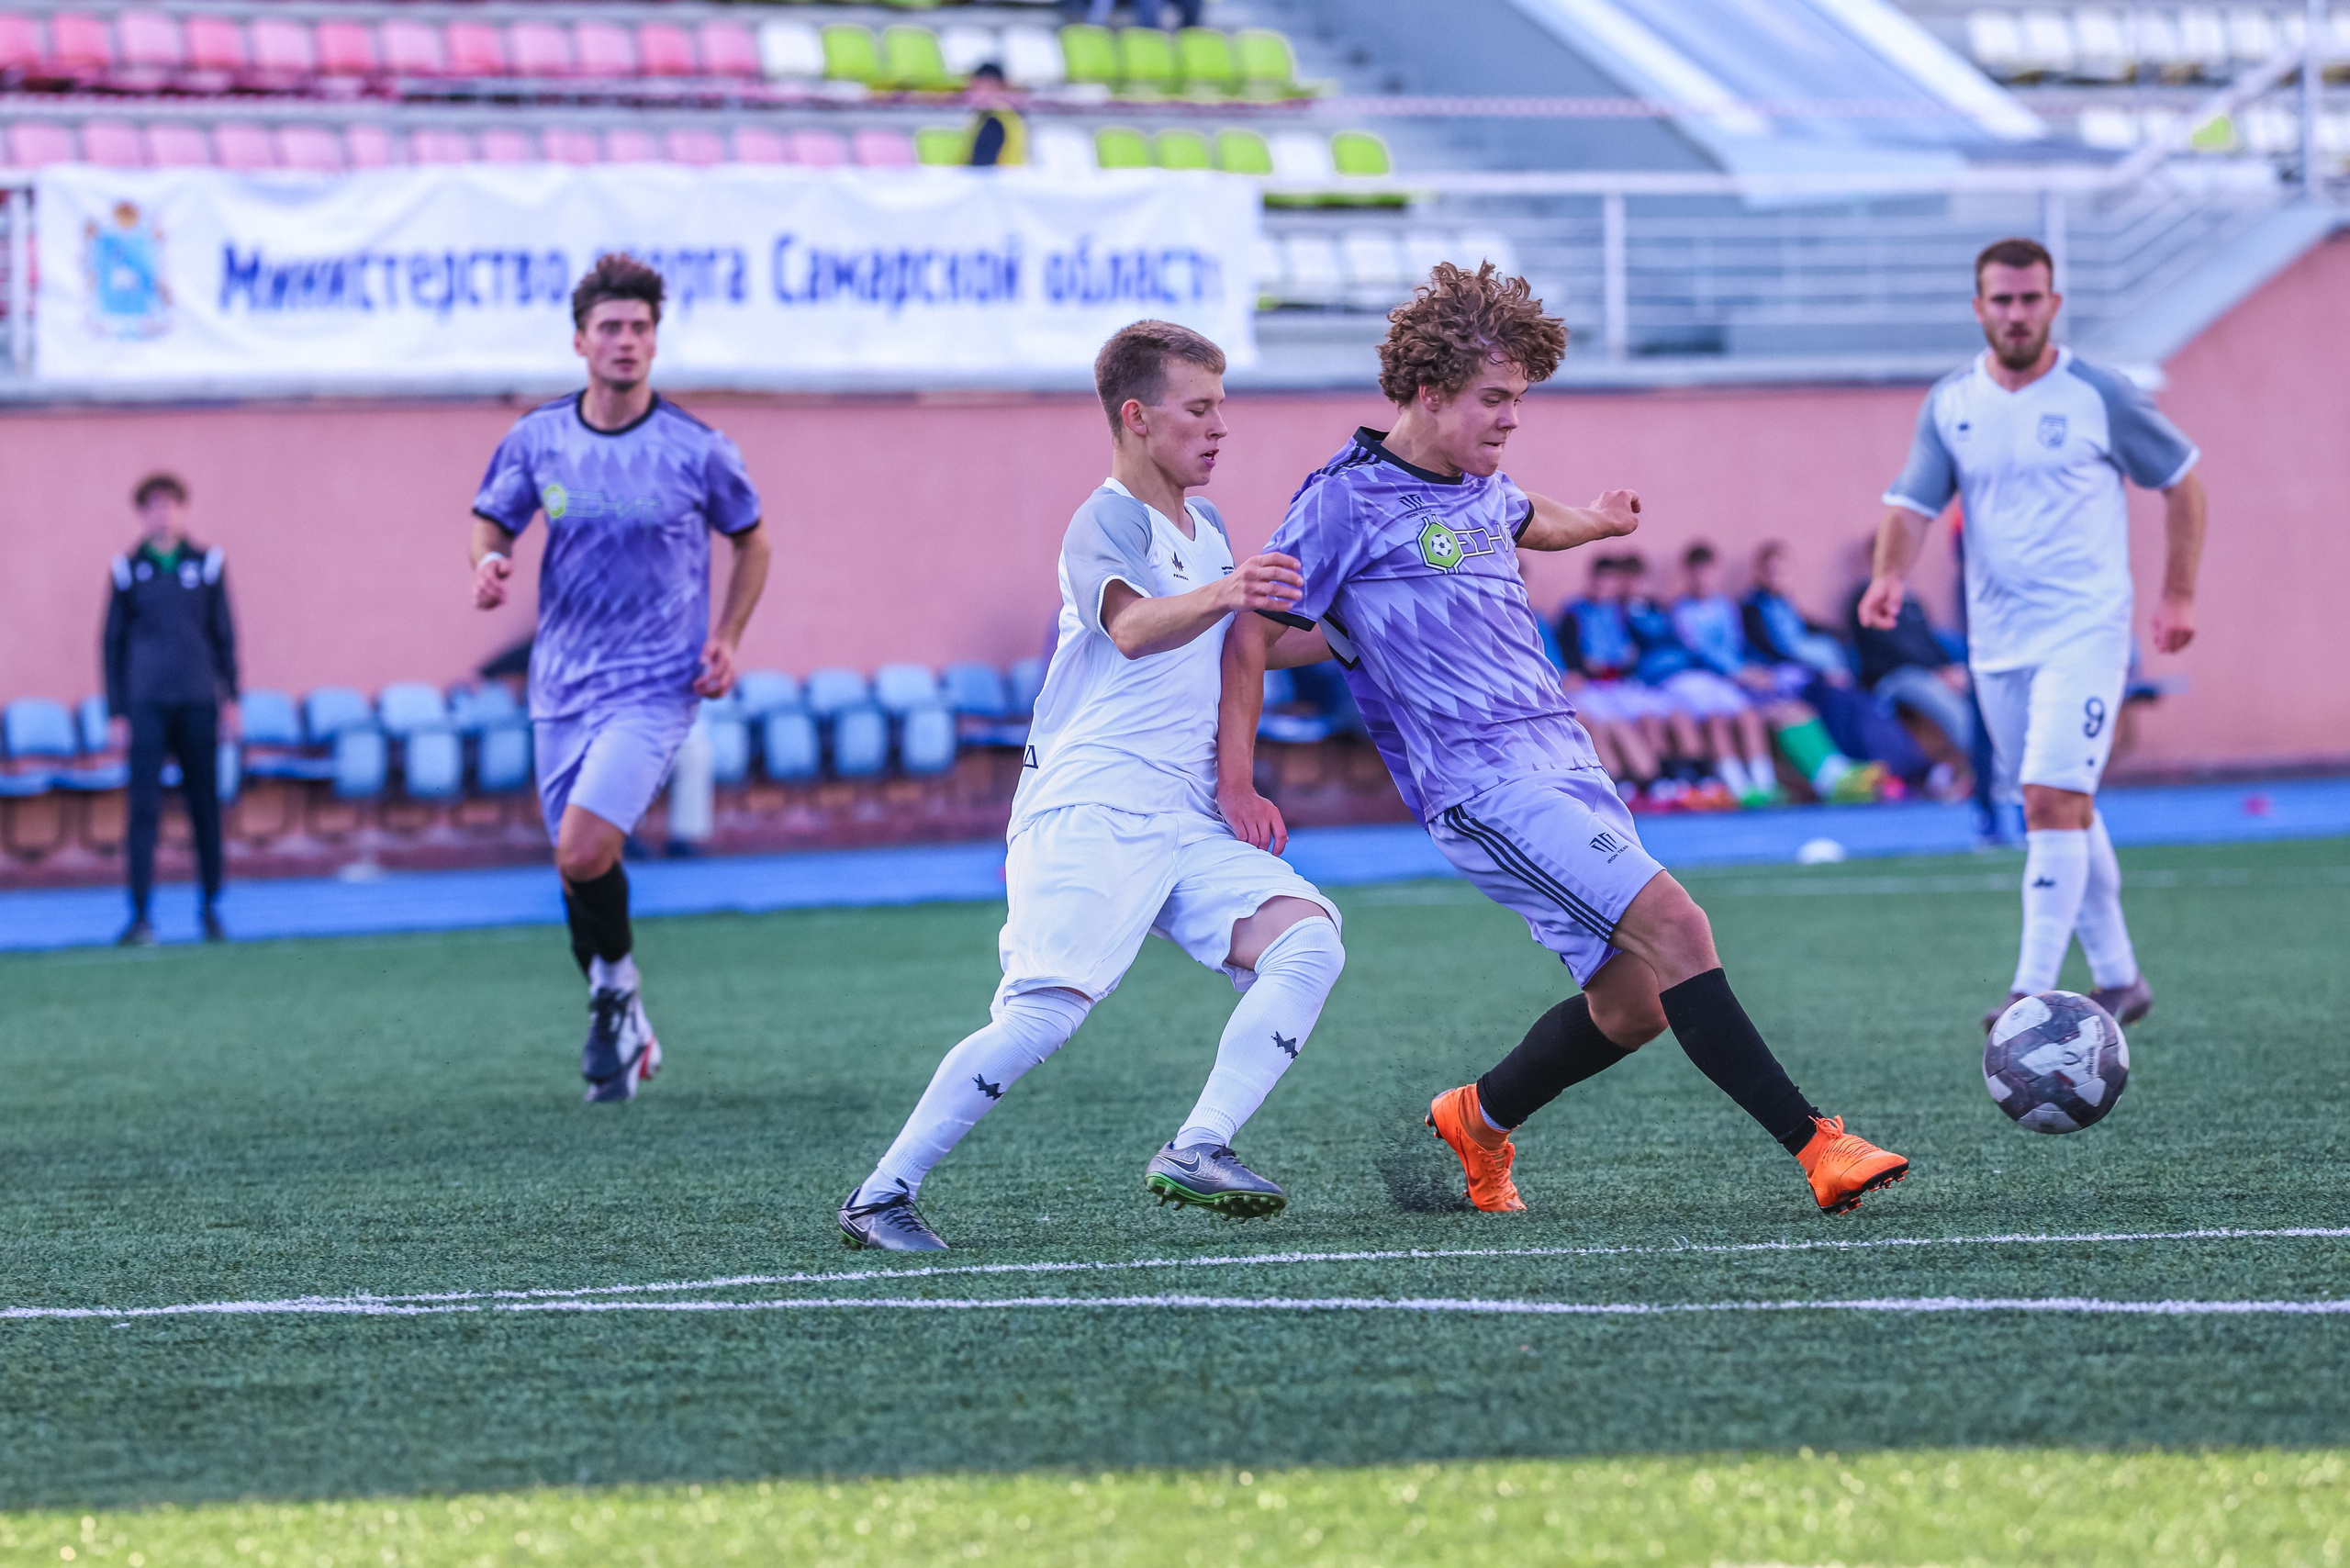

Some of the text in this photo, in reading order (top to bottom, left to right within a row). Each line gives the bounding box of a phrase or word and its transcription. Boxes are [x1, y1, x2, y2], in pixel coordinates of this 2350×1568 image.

[220, 241, 571, 320] Министерство
[596, 248, 747, 318] орта
[772, 233, 1019, 318] Самарской
[2084, 696, 2105, 738] 9
